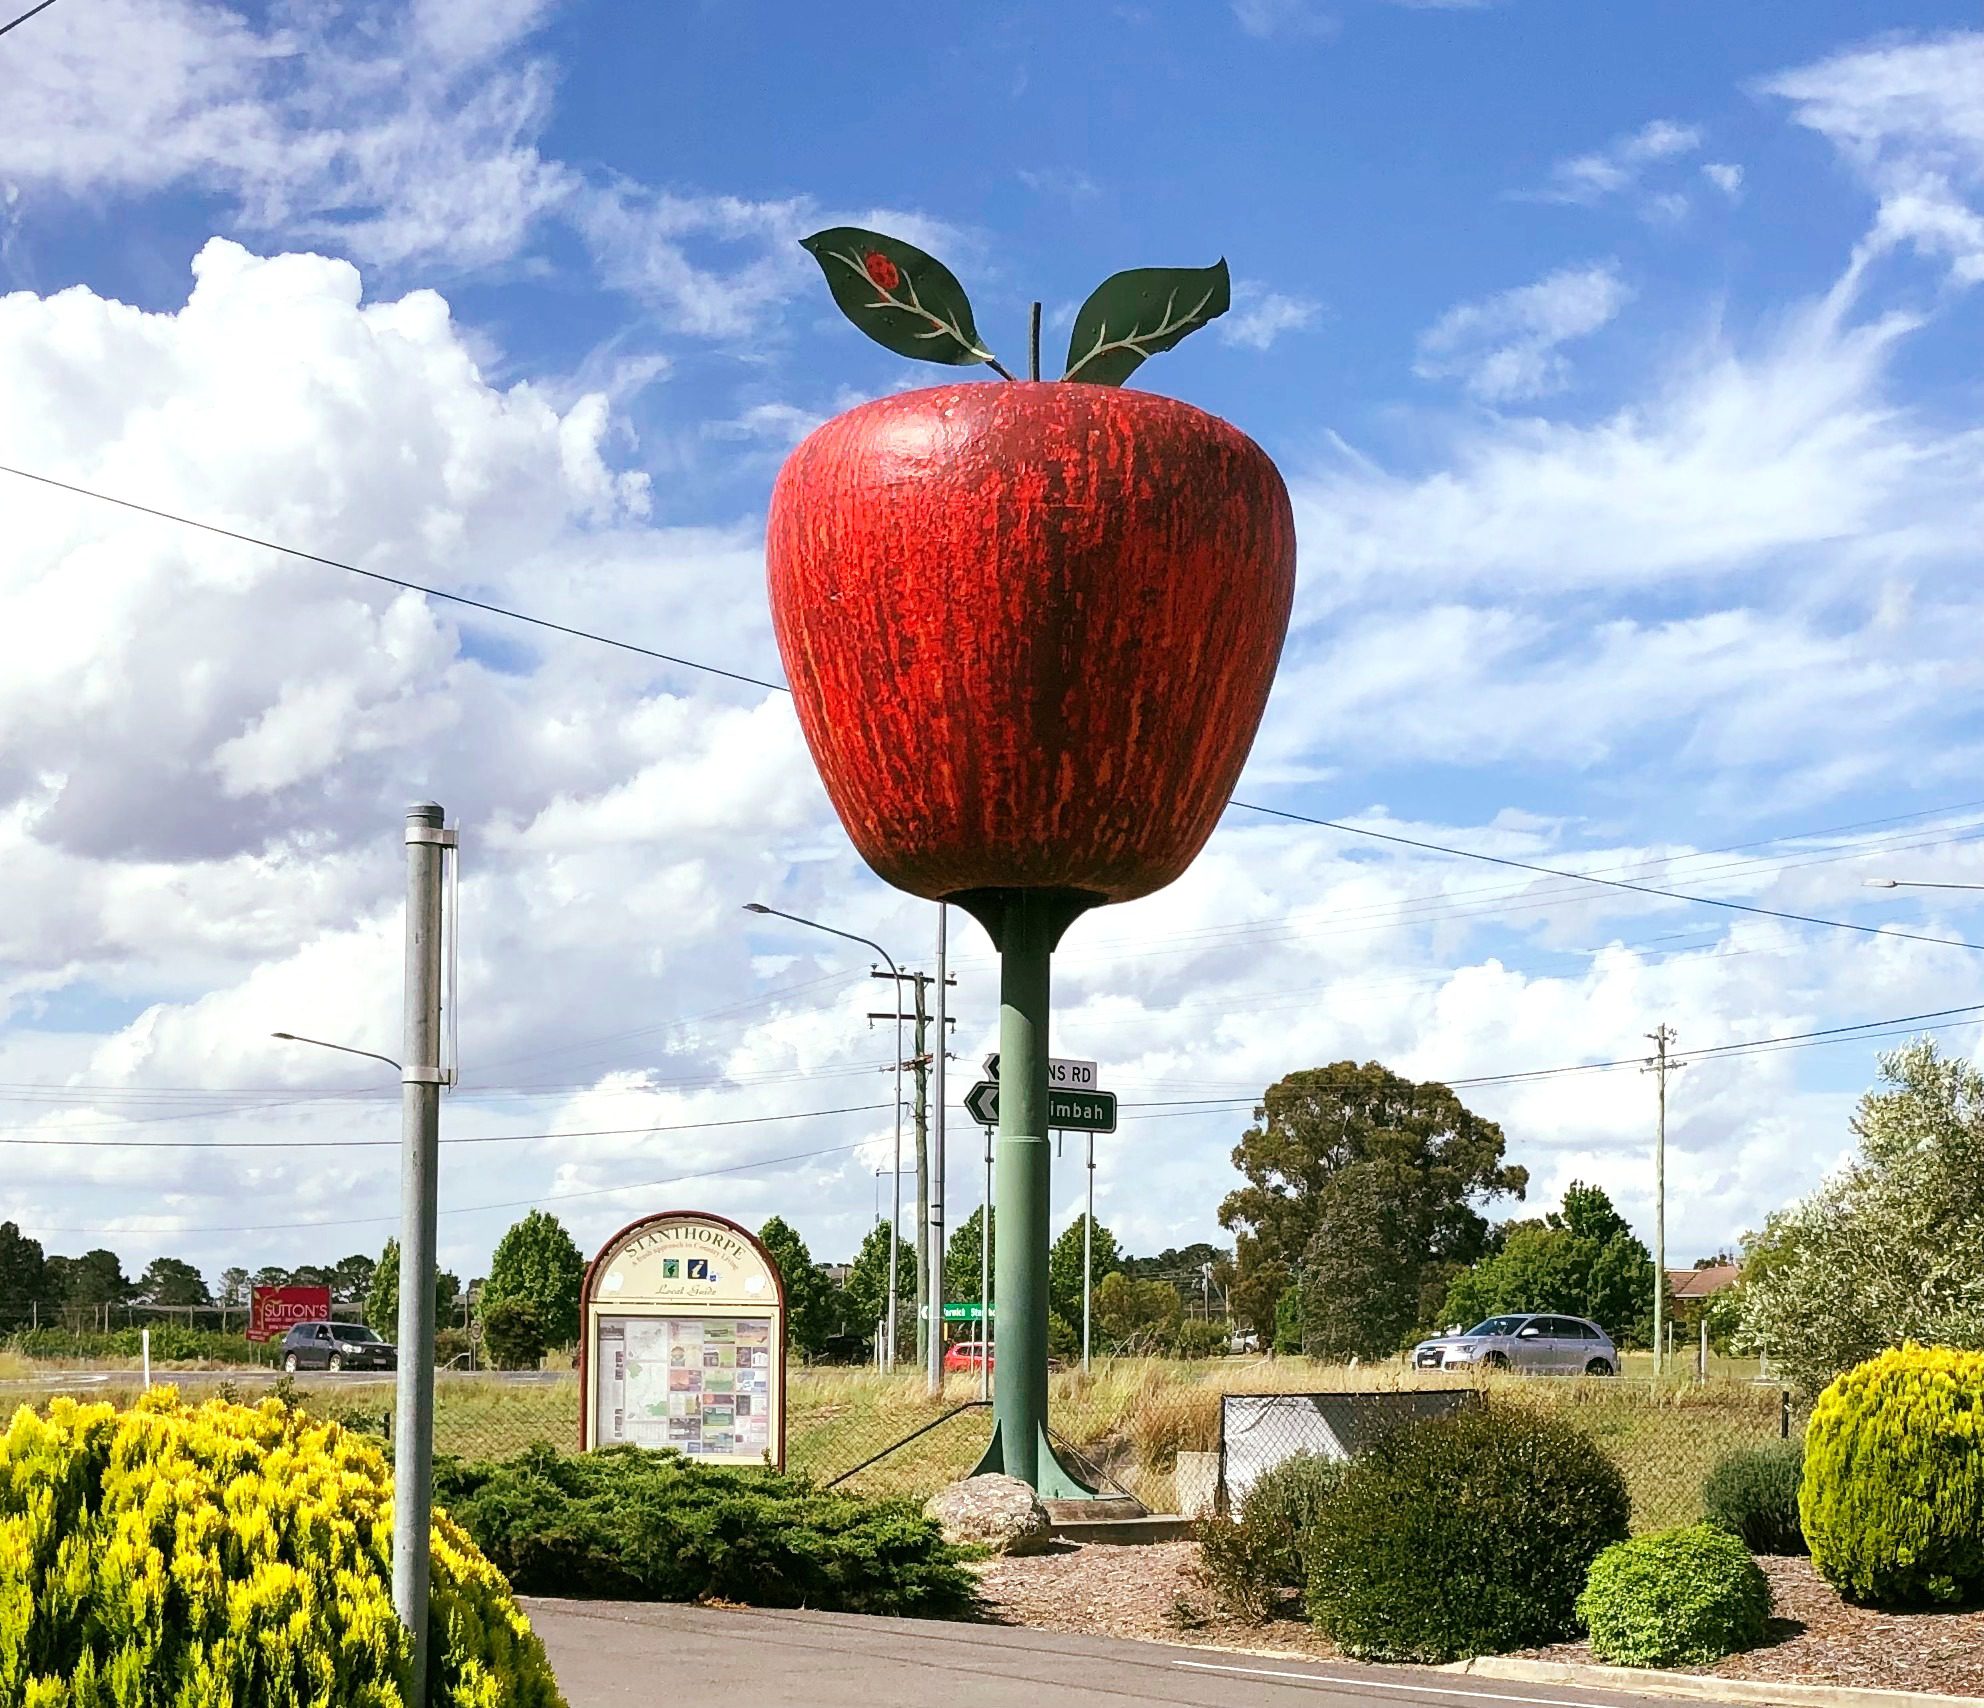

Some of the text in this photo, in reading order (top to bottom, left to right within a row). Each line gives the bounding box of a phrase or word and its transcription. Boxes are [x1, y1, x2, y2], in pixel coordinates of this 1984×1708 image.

[1072, 1067, 1091, 1083] RD
[624, 1227, 748, 1261] STANTHORPE
[656, 1284, 717, 1297] Local Guide
[264, 1303, 328, 1318] SUTTON'S
